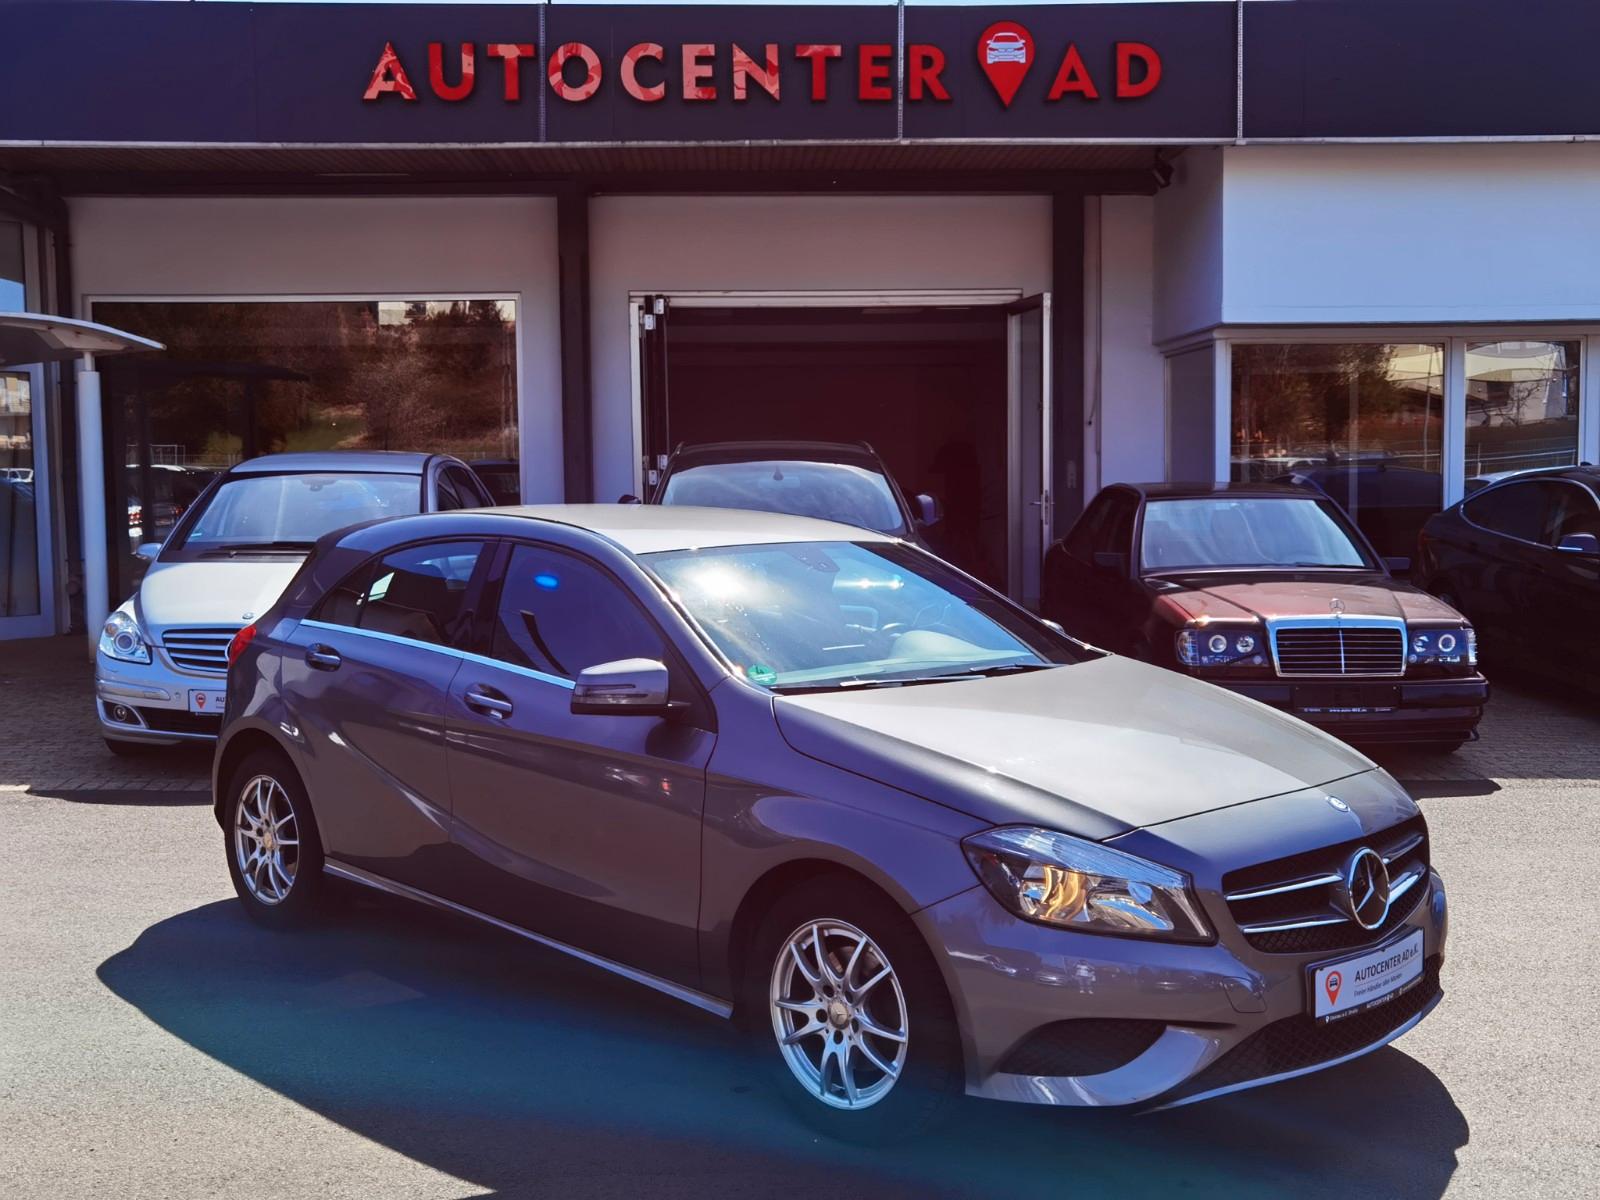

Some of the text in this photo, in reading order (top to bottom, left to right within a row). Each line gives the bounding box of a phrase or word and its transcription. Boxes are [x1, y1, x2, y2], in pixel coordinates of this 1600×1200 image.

[363, 42, 1162, 102] AUTOCENTER AD
[1355, 954, 1401, 982] AUTOCENTER
